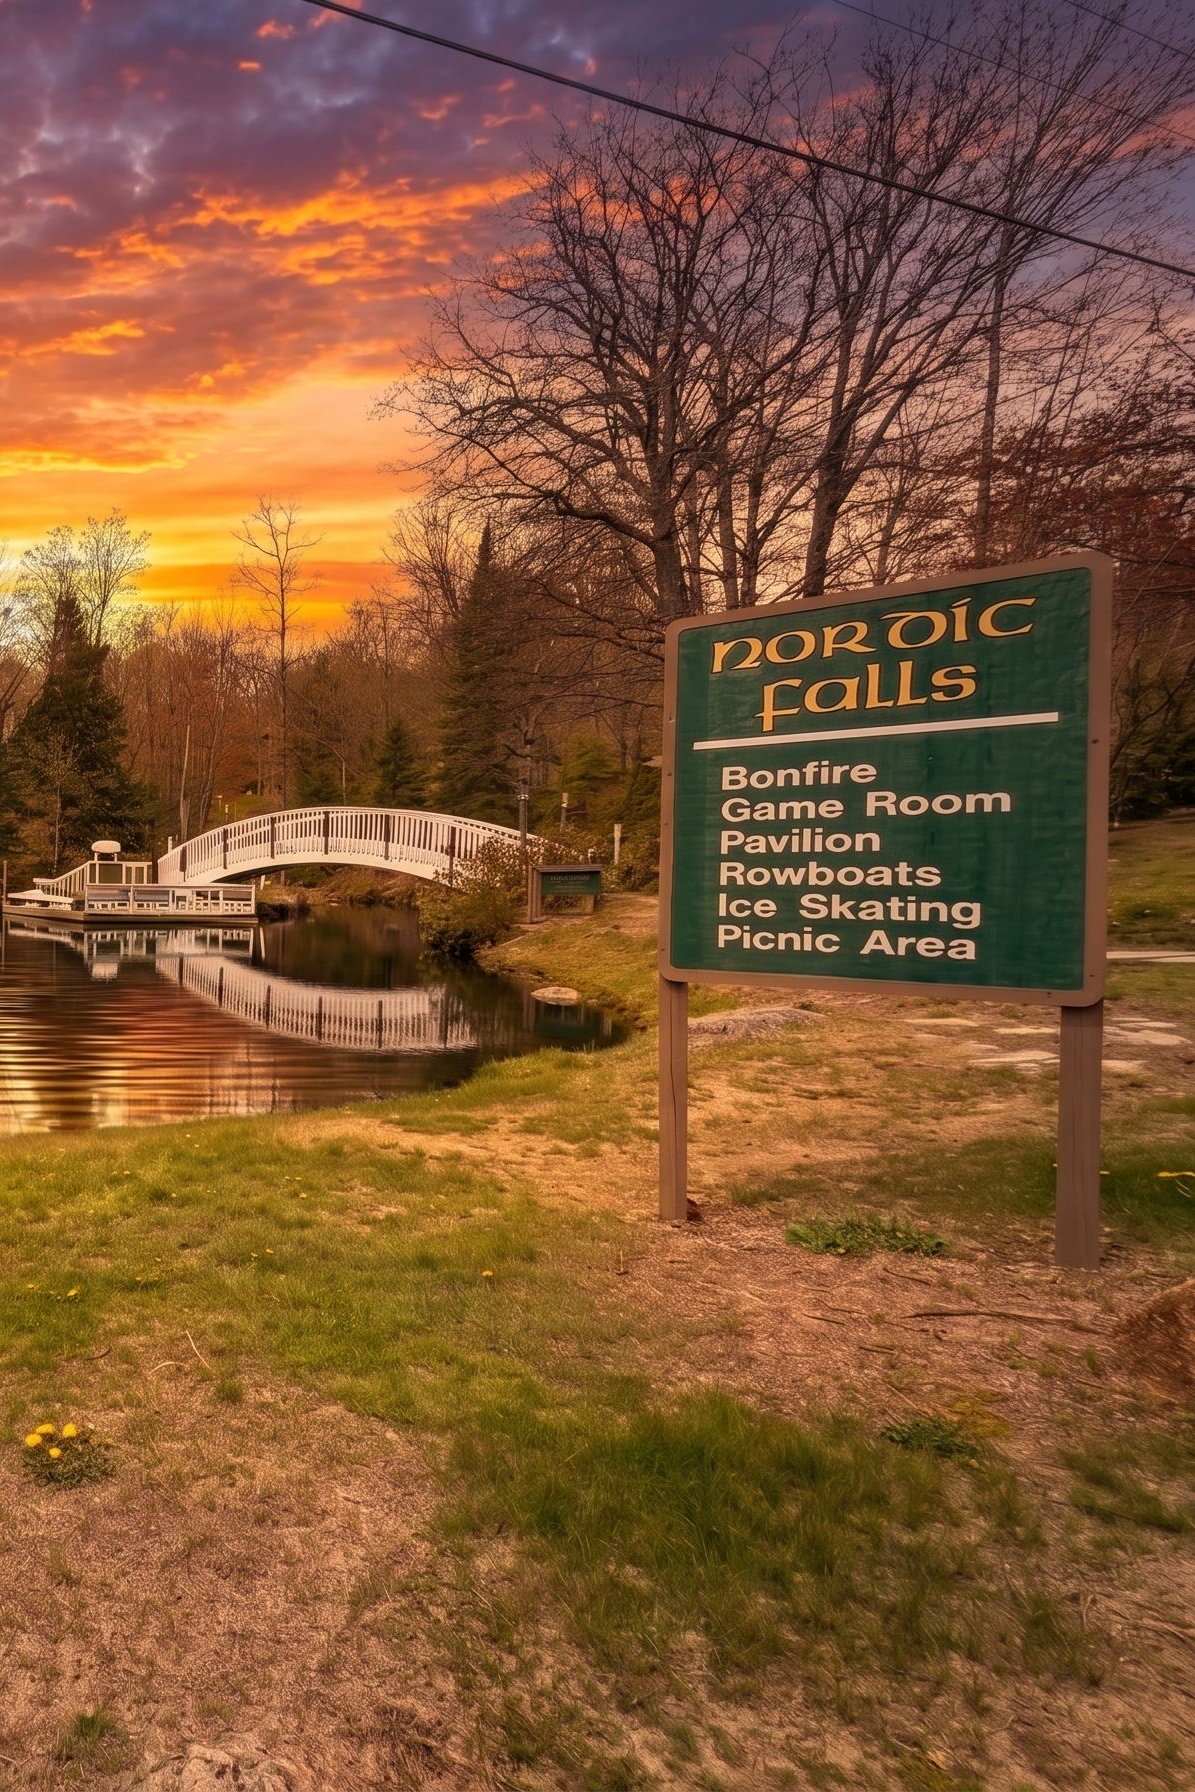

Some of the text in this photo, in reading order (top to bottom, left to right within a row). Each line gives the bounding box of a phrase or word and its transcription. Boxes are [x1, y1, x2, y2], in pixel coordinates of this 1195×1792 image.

[722, 761, 877, 790] Bonfire
[722, 791, 1010, 822] Game Room
[721, 828, 880, 854] Pavilion
[720, 861, 941, 886] Rowboats
[719, 893, 980, 929] Ice Skating
[718, 925, 975, 959] Picnic Area
